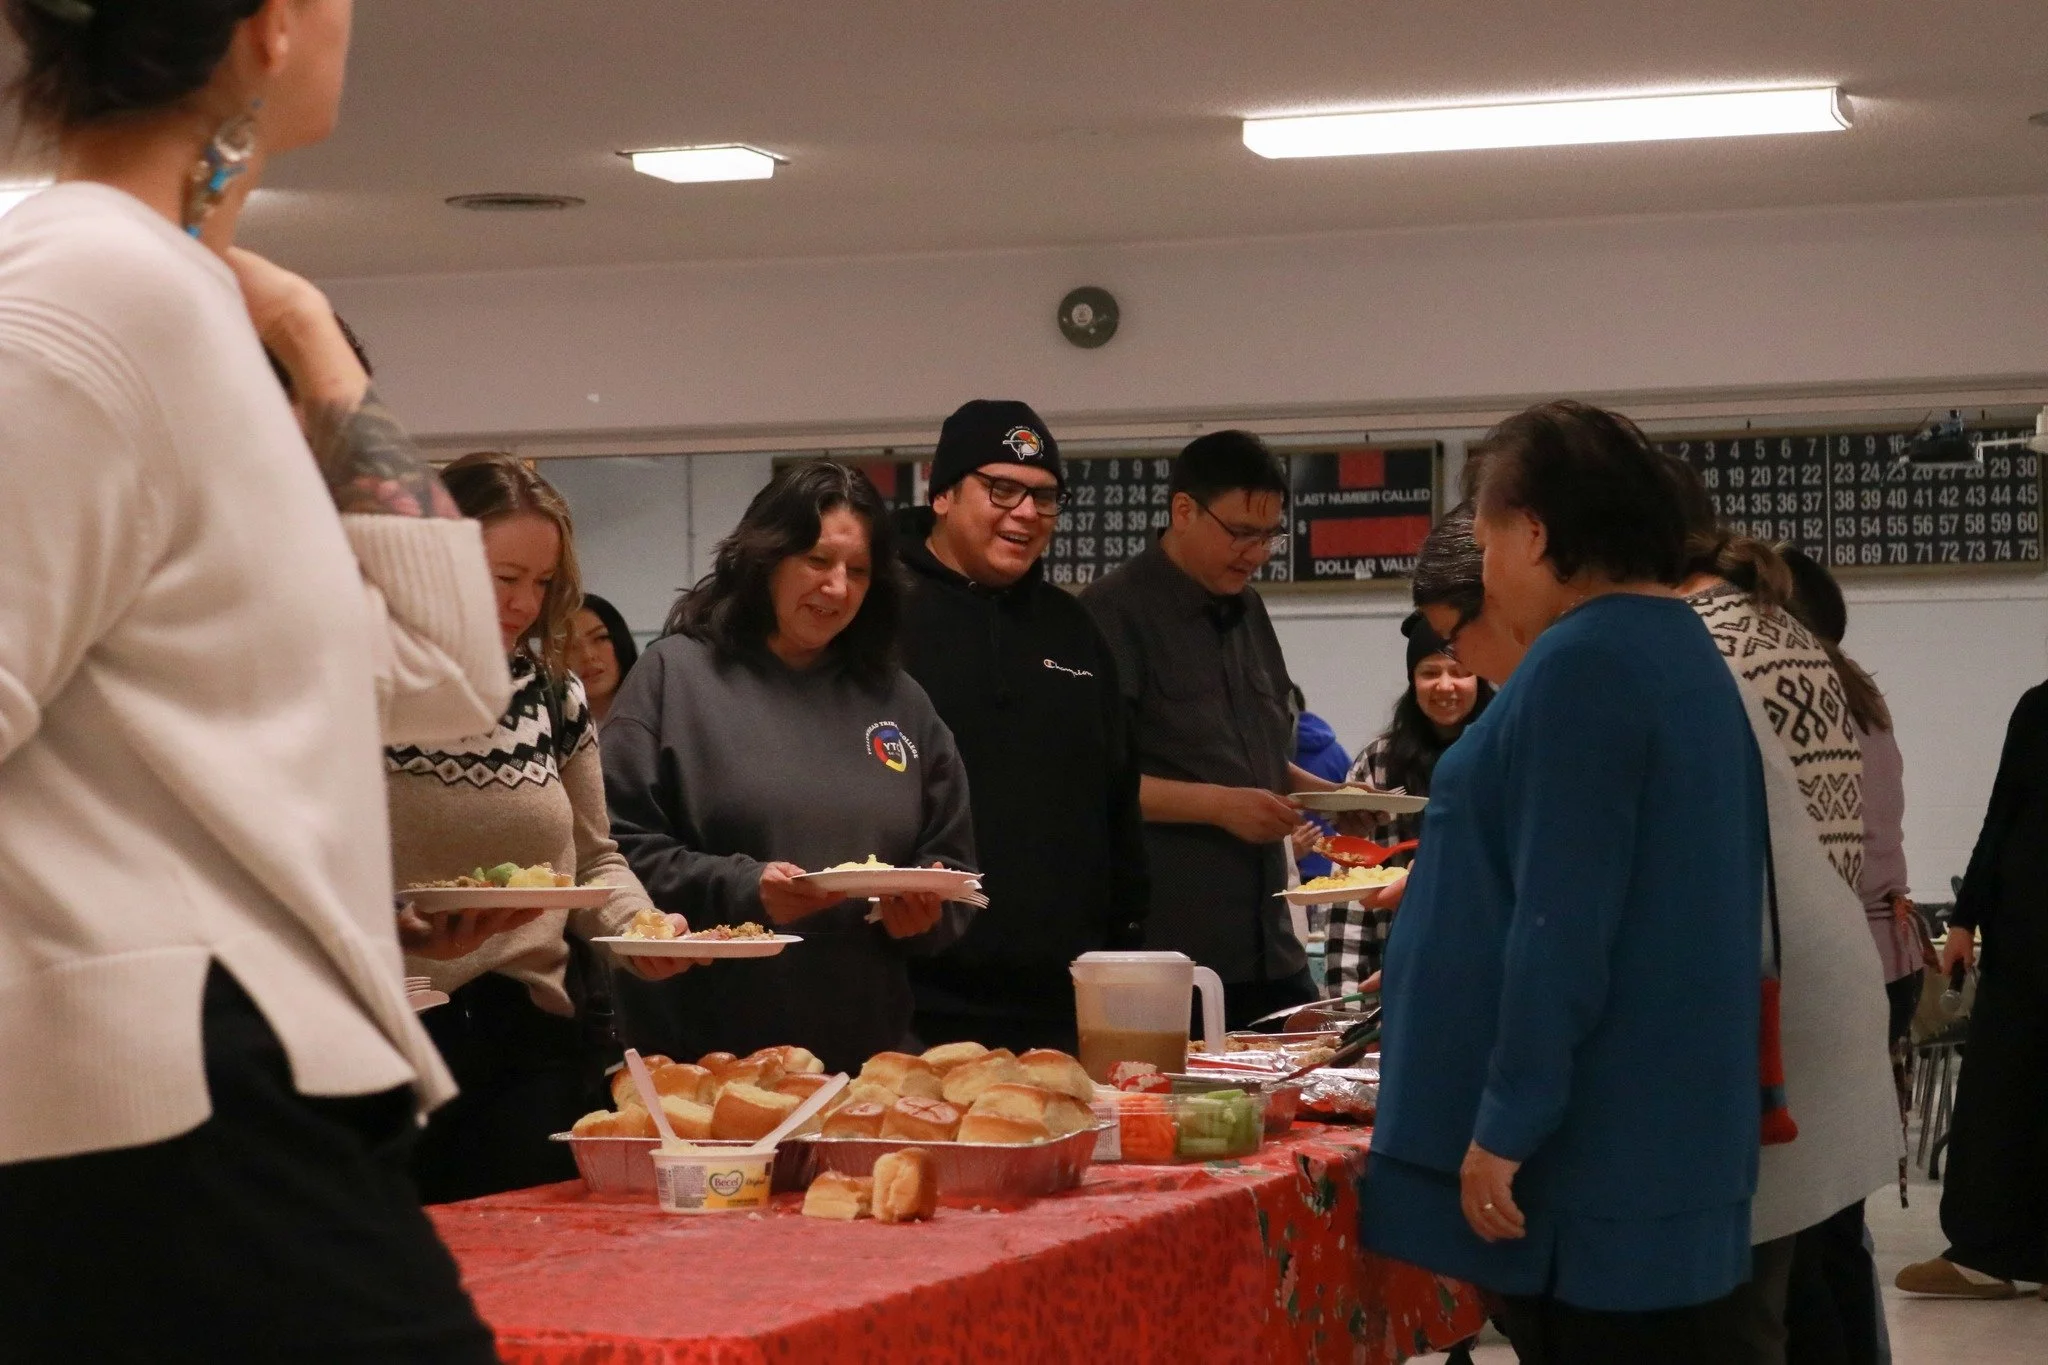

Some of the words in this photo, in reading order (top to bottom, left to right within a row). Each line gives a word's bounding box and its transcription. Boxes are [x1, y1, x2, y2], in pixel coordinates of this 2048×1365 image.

[1680, 441, 1690, 462] 2
[1705, 441, 1716, 462] 3
[1729, 440, 1740, 460] 4
[1755, 439, 1766, 460] 5
[1781, 438, 1792, 459] 6
[1806, 438, 1817, 458] 7
[1839, 436, 1850, 457] 8
[1865, 435, 1876, 456] 9
[1082, 460, 1092, 480] 7
[1109, 459, 1120, 480] 8
[1133, 459, 1143, 480] 9
[1153, 459, 1170, 478] 10
[1702, 468, 1719, 488] 18
[1728, 466, 1745, 487] 19
[1751, 465, 1772, 486] 20
[1777, 465, 1796, 486] 21
[1802, 464, 1822, 486] 22
[1834, 462, 1855, 484] 23
[1861, 461, 1880, 482] 24
[1990, 458, 2010, 478] 29
[2016, 456, 2038, 478] 30
[1076, 485, 1096, 505] 22
[1104, 484, 1124, 505] 23
[1128, 484, 1146, 504] 24
[1152, 484, 1170, 504] 25
[1296, 493, 1326, 506] LAST
[1328, 490, 1380, 504] NUMBER
[1382, 488, 1430, 503] CALLED
[1726, 494, 1746, 514] 34
[1752, 493, 1772, 514] 35
[1777, 492, 1798, 513] 36
[1802, 492, 1822, 512] 37
[1834, 490, 1855, 512] 38
[1861, 489, 1881, 510] 39
[1887, 488, 1908, 509] 40
[1913, 487, 1933, 508] 41
[1939, 486, 1960, 508] 42
[1965, 485, 1986, 507] 43
[1990, 484, 2011, 506] 44
[2016, 484, 2038, 505] 45
[1055, 512, 1072, 532] 36
[1076, 511, 1096, 532] 37
[1104, 511, 1124, 531] 38
[1128, 510, 1147, 531] 39
[1151, 510, 1170, 528] 40
[1297, 520, 1307, 536] $
[1752, 520, 1772, 541] 50
[1778, 519, 1796, 540] 51
[1802, 518, 1823, 540] 52
[1835, 516, 1856, 538] 53
[1861, 516, 1881, 538] 54
[1887, 515, 1908, 537] 55
[1912, 514, 1934, 536] 56
[1939, 513, 1960, 535] 57
[1965, 512, 1986, 534] 58
[1990, 512, 2012, 534] 59
[2017, 510, 2038, 533] 60
[1055, 537, 1072, 558] 51
[1077, 536, 1096, 558] 52
[1104, 536, 1124, 557] 53
[1835, 544, 1856, 564] 68
[1861, 543, 1882, 564] 69
[1887, 542, 1908, 564] 70
[1914, 542, 1932, 563] 71
[1939, 541, 1960, 563] 72
[1965, 540, 1986, 562] 73
[1992, 540, 2011, 561] 74
[2018, 539, 2038, 560] 75
[1052, 563, 1072, 584] 66
[1076, 562, 1096, 584] 67
[1268, 560, 1288, 582] 75
[1314, 559, 1376, 575] DOLLAR
[714, 1178, 739, 1187] Becel
